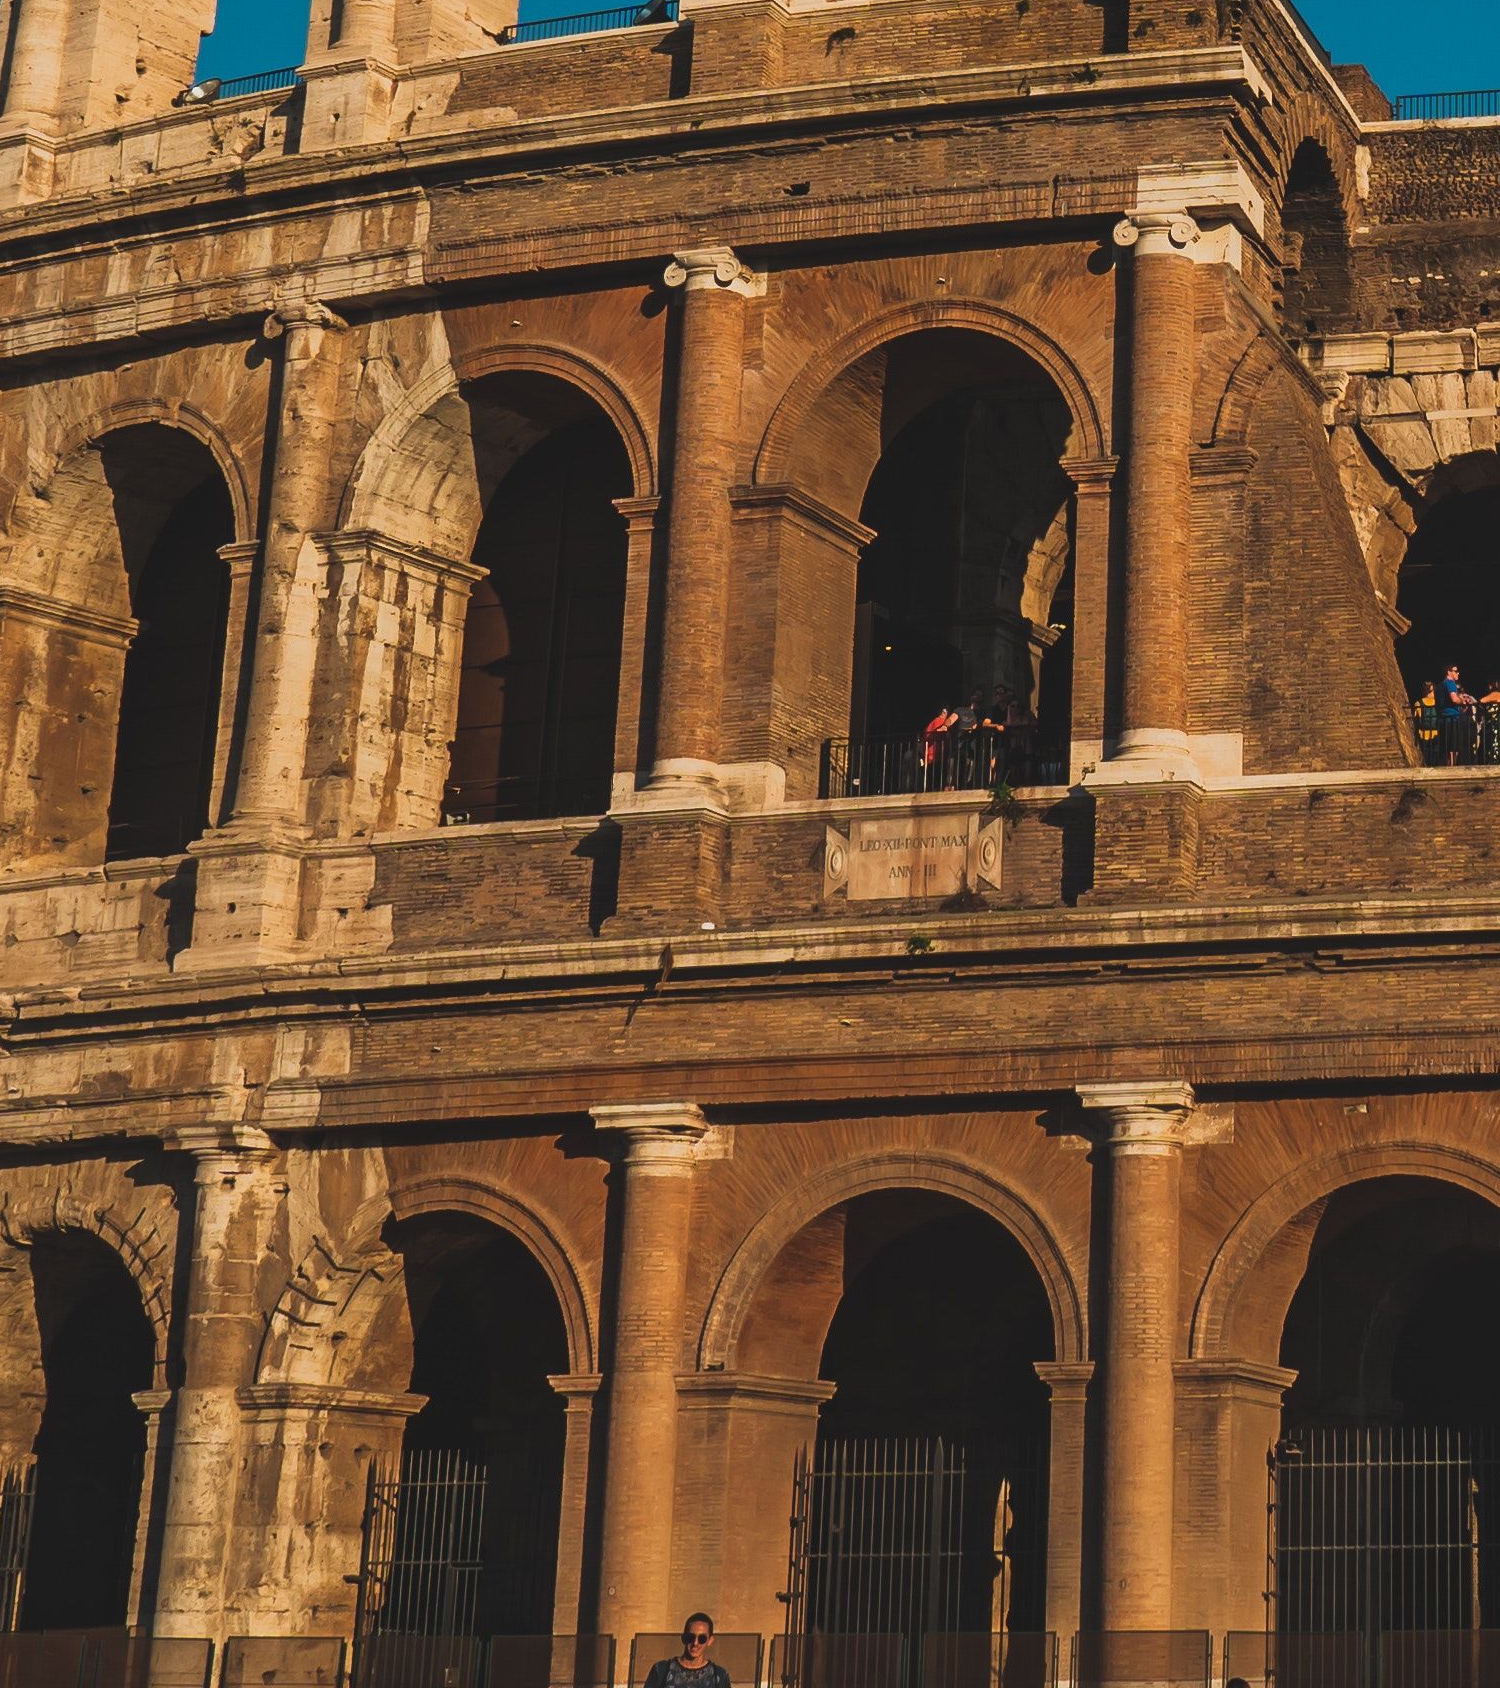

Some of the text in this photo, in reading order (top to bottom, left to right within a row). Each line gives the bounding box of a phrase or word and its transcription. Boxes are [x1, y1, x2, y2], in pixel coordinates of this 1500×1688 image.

[860, 840, 881, 852] LEO
[905, 836, 937, 850] PONT
[942, 835, 968, 848] MAX
[924, 864, 937, 877] III
